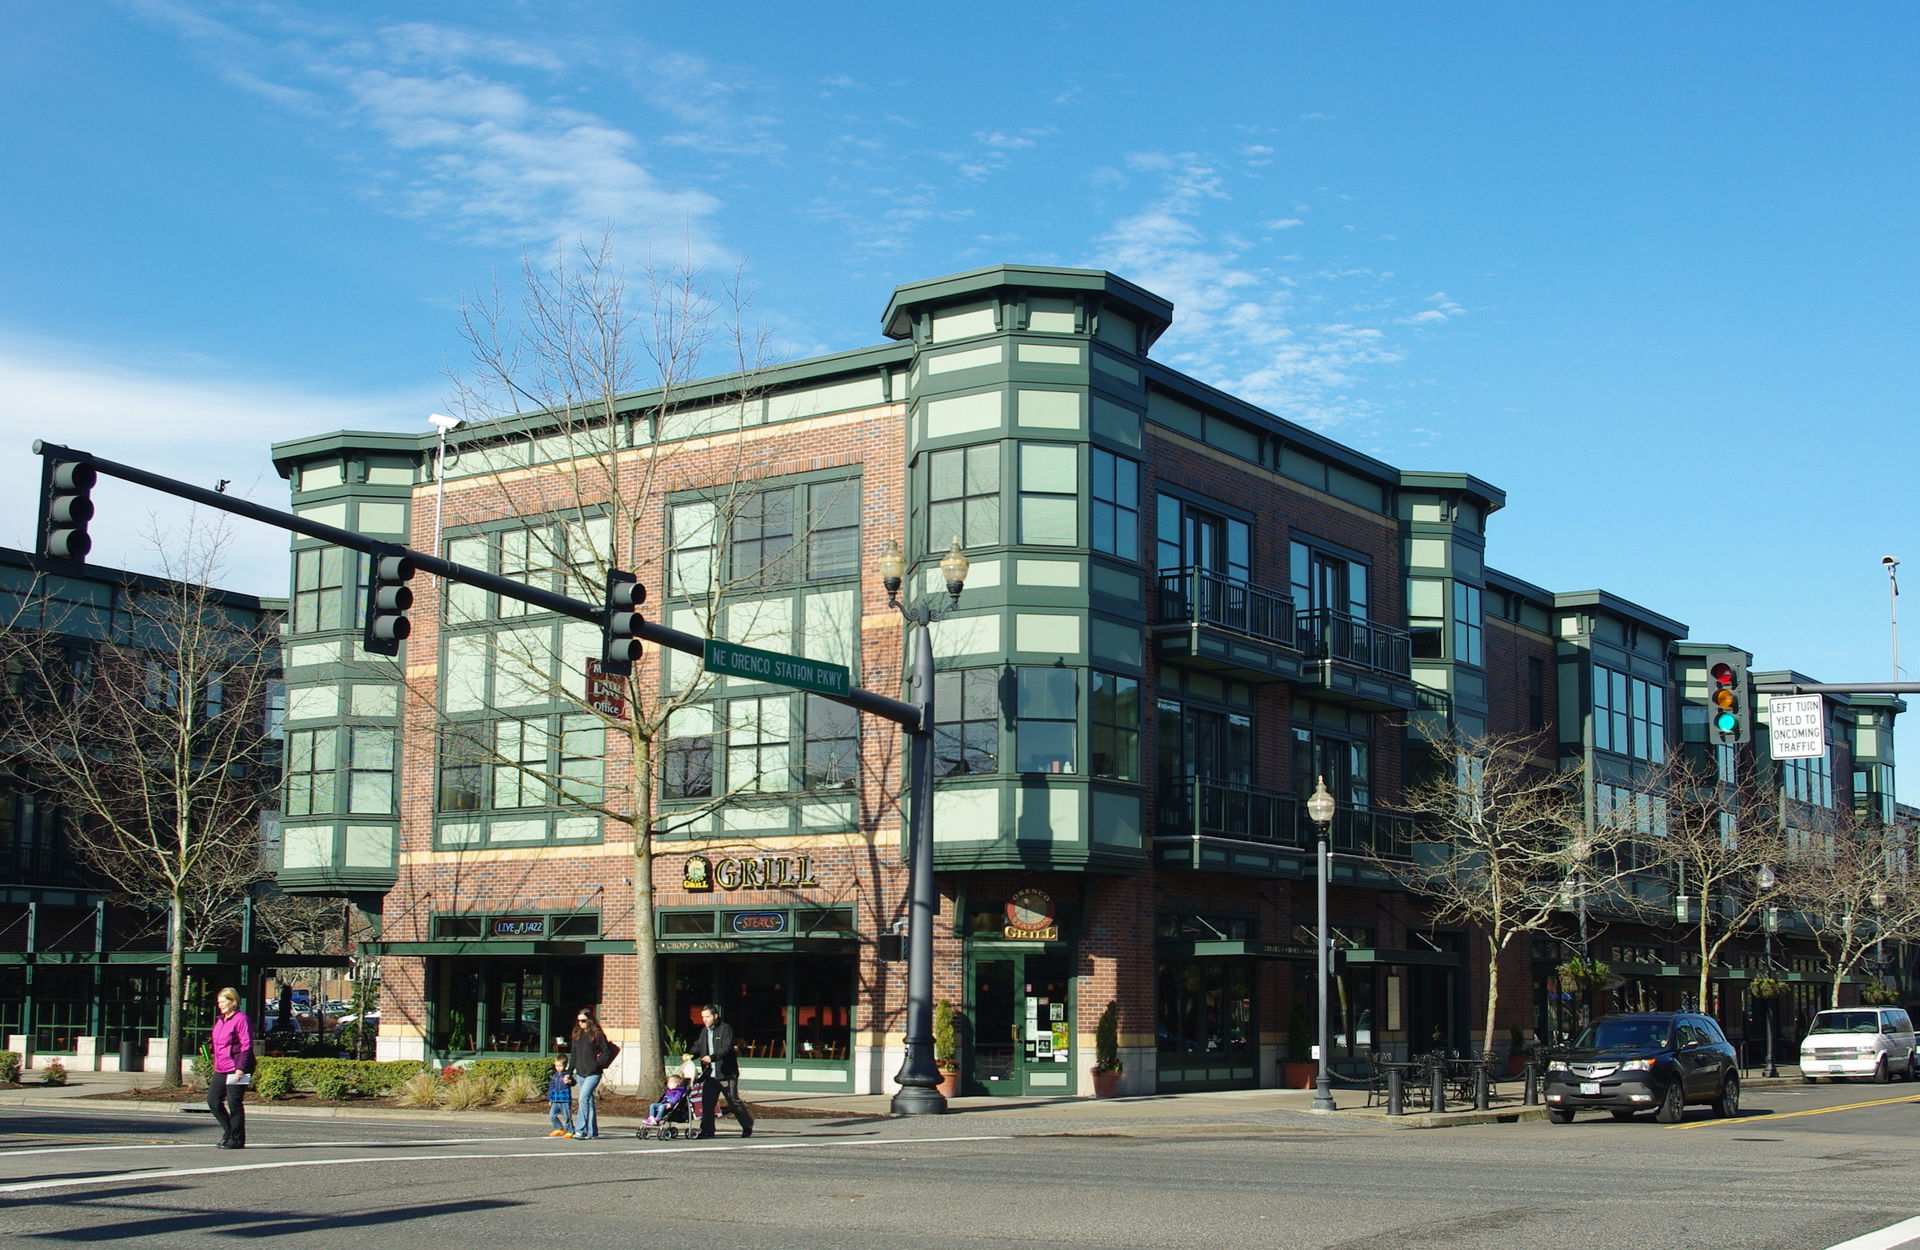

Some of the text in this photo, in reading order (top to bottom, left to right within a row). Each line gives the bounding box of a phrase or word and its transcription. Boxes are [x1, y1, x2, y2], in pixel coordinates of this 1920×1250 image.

[713, 648, 842, 690] NE ORENCO STATION PKWY
[593, 701, 619, 714] Office
[1771, 700, 1819, 713] LEFT TURN
[1776, 714, 1816, 726] YIELD TO
[1773, 727, 1820, 740] ONCOMING
[1779, 741, 1816, 753] TRAFFIC
[716, 856, 818, 890] GRILL
[498, 922, 543, 933] LIVE JAZZ
[742, 917, 775, 929] STEAKS
[1004, 925, 1056, 939] GRILL
